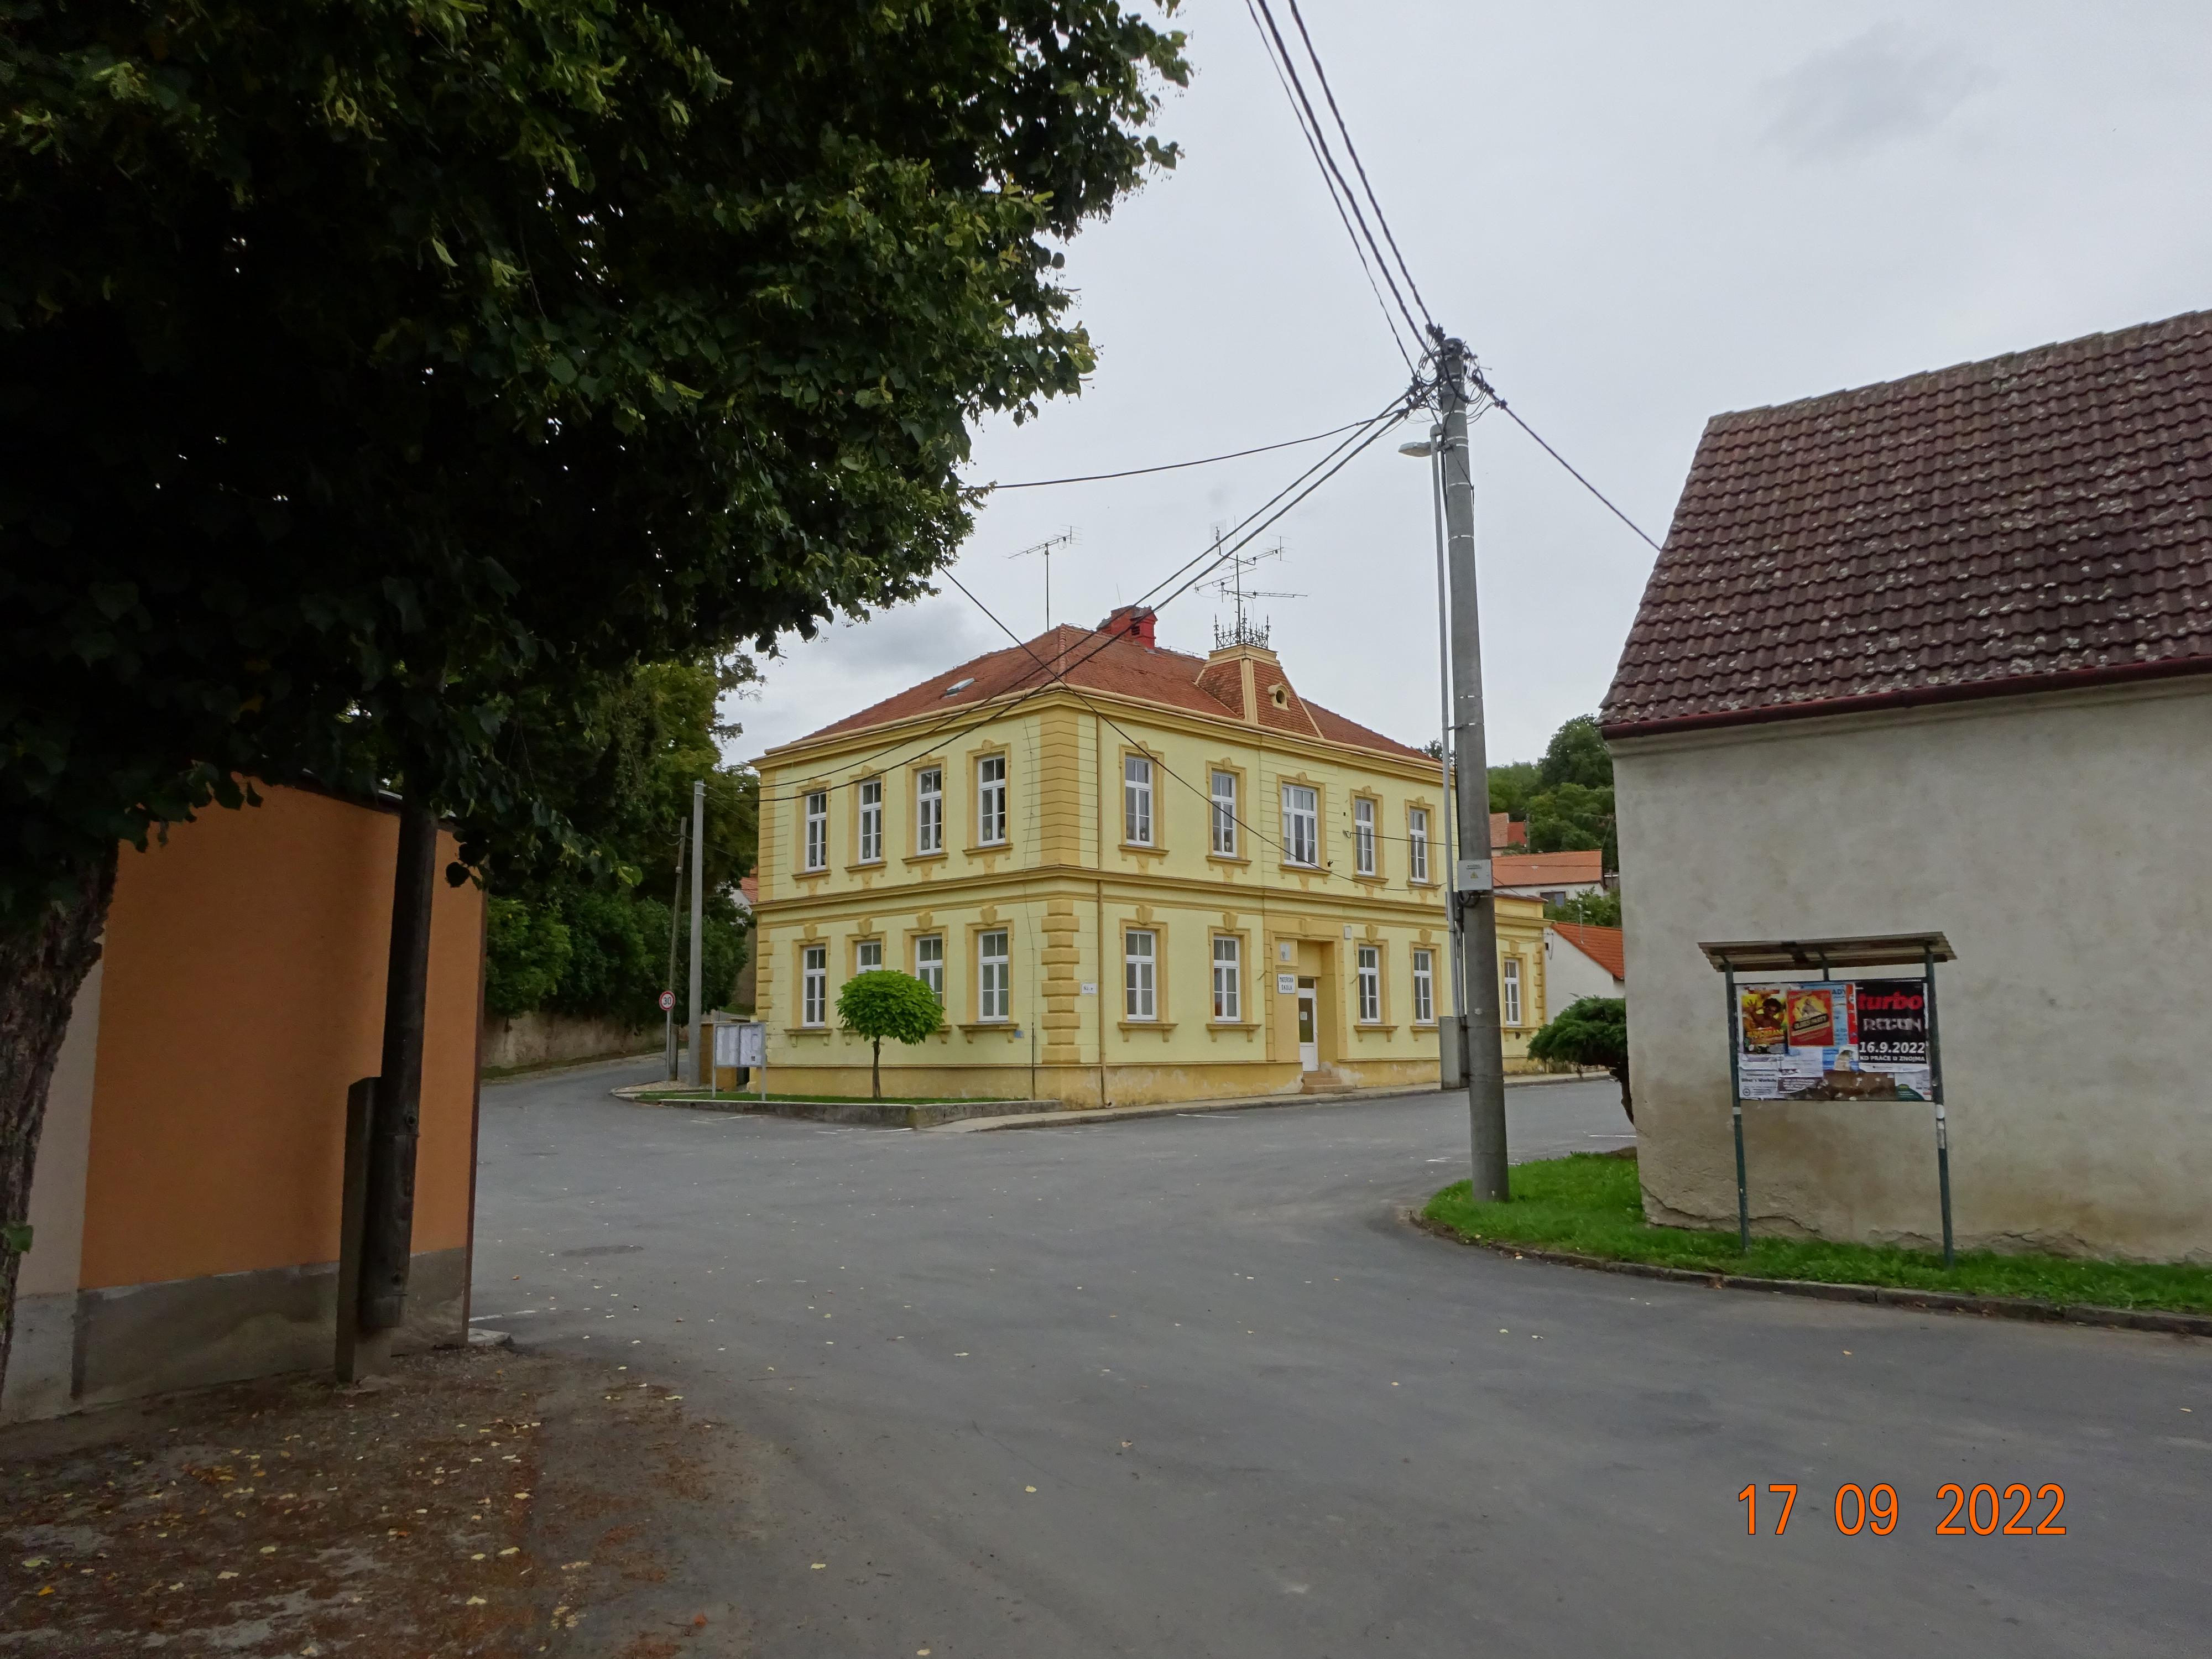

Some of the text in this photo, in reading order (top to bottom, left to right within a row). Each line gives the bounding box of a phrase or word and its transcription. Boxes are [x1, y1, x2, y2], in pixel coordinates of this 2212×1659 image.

[664, 997, 671, 1005] 30
[1858, 991, 1923, 1010] turbo
[1859, 1042, 1925, 1053] 16.9.2022
